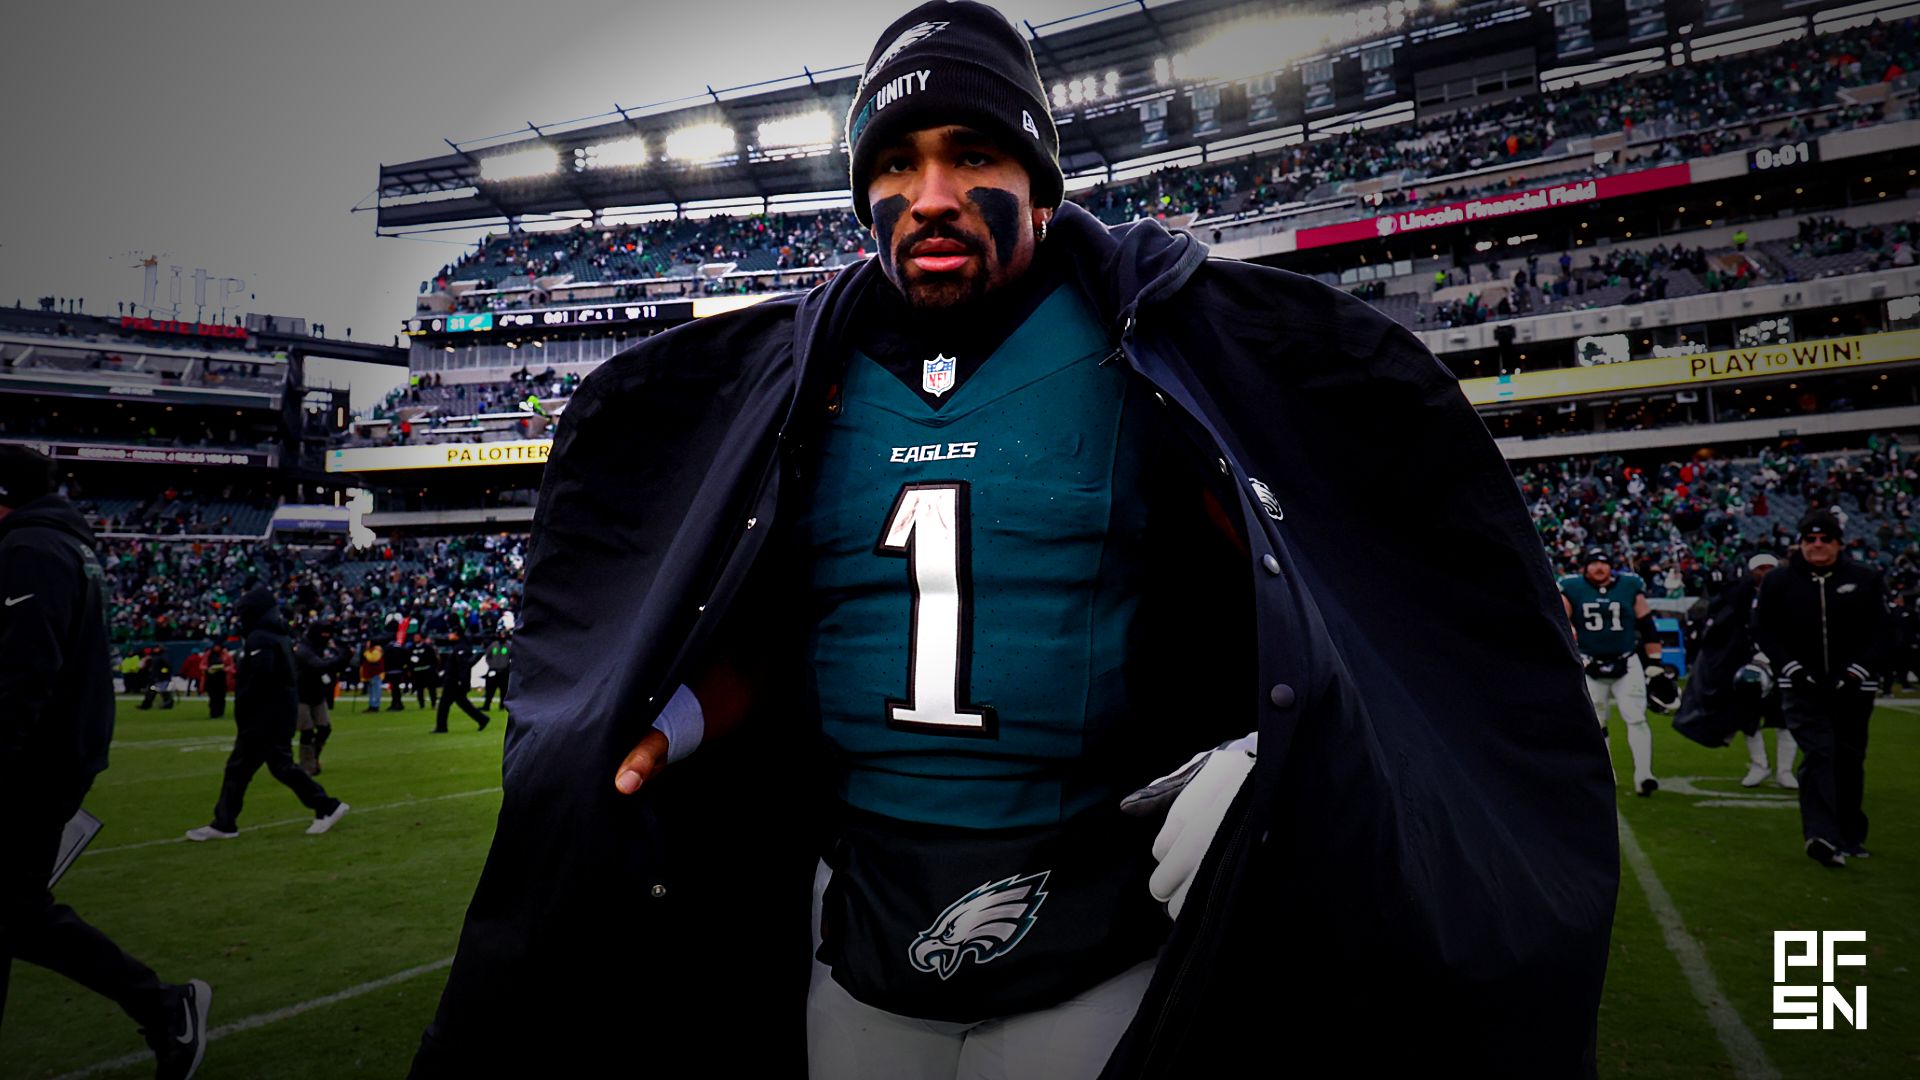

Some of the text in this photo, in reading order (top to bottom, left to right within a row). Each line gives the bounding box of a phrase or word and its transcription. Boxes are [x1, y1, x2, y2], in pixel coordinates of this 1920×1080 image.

[1755, 141, 1810, 170] 0:01
[1401, 180, 1598, 232] Lincoln Financial Field
[1691, 341, 1863, 377] PLAY TO WIN!
[928, 371, 949, 389] NFL
[447, 445, 549, 462] PA LOTTER
[889, 441, 979, 464] EAGLES
[878, 484, 990, 734] 1
[1582, 601, 1625, 632] 51
